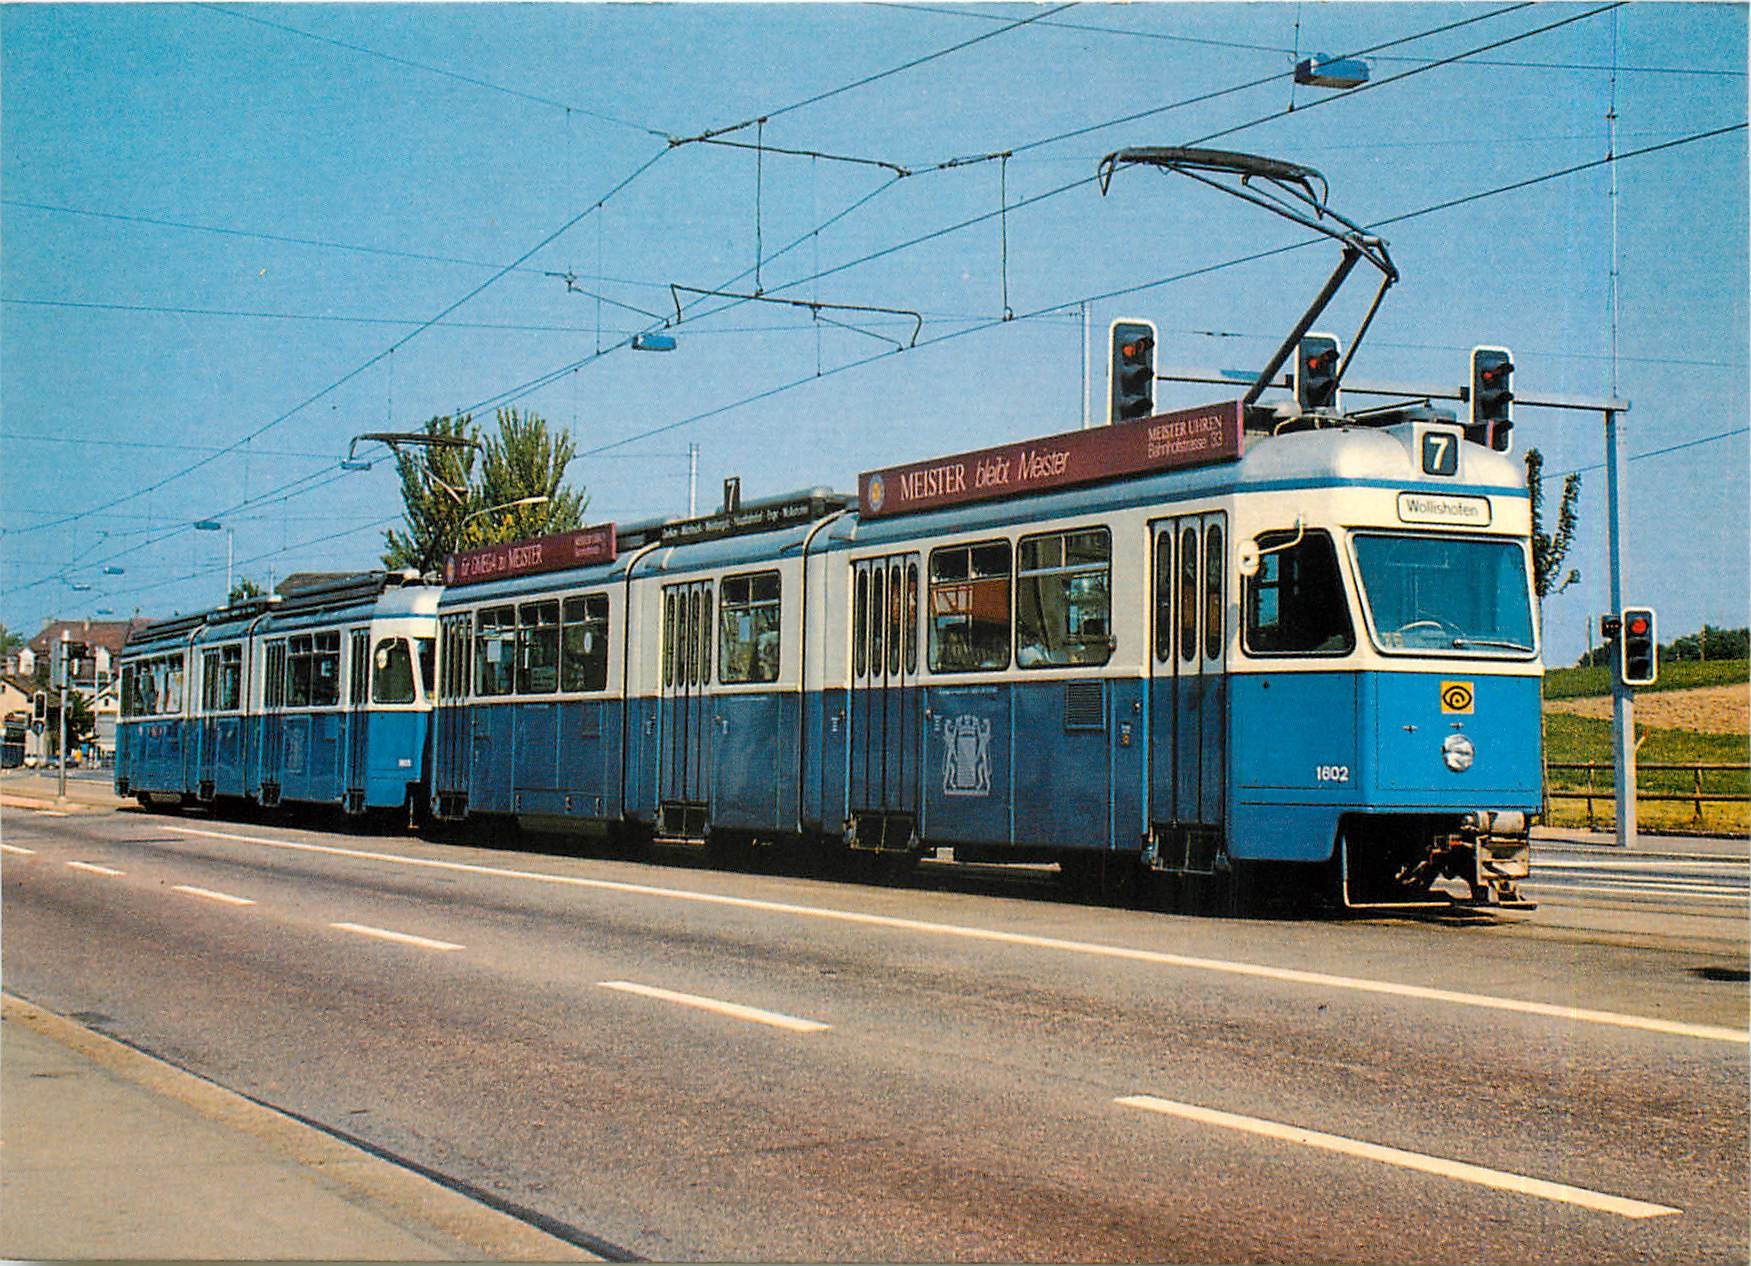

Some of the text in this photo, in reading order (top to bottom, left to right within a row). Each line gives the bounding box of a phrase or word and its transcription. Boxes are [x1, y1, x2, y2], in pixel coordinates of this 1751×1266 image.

[1148, 421, 1187, 440] MEISTER
[1429, 436, 1449, 470] 7
[900, 448, 1071, 502] MEISTER bleibt Meister
[726, 479, 737, 513] 7
[1405, 498, 1480, 517] Wollishofen
[1316, 765, 1350, 781] 1602
